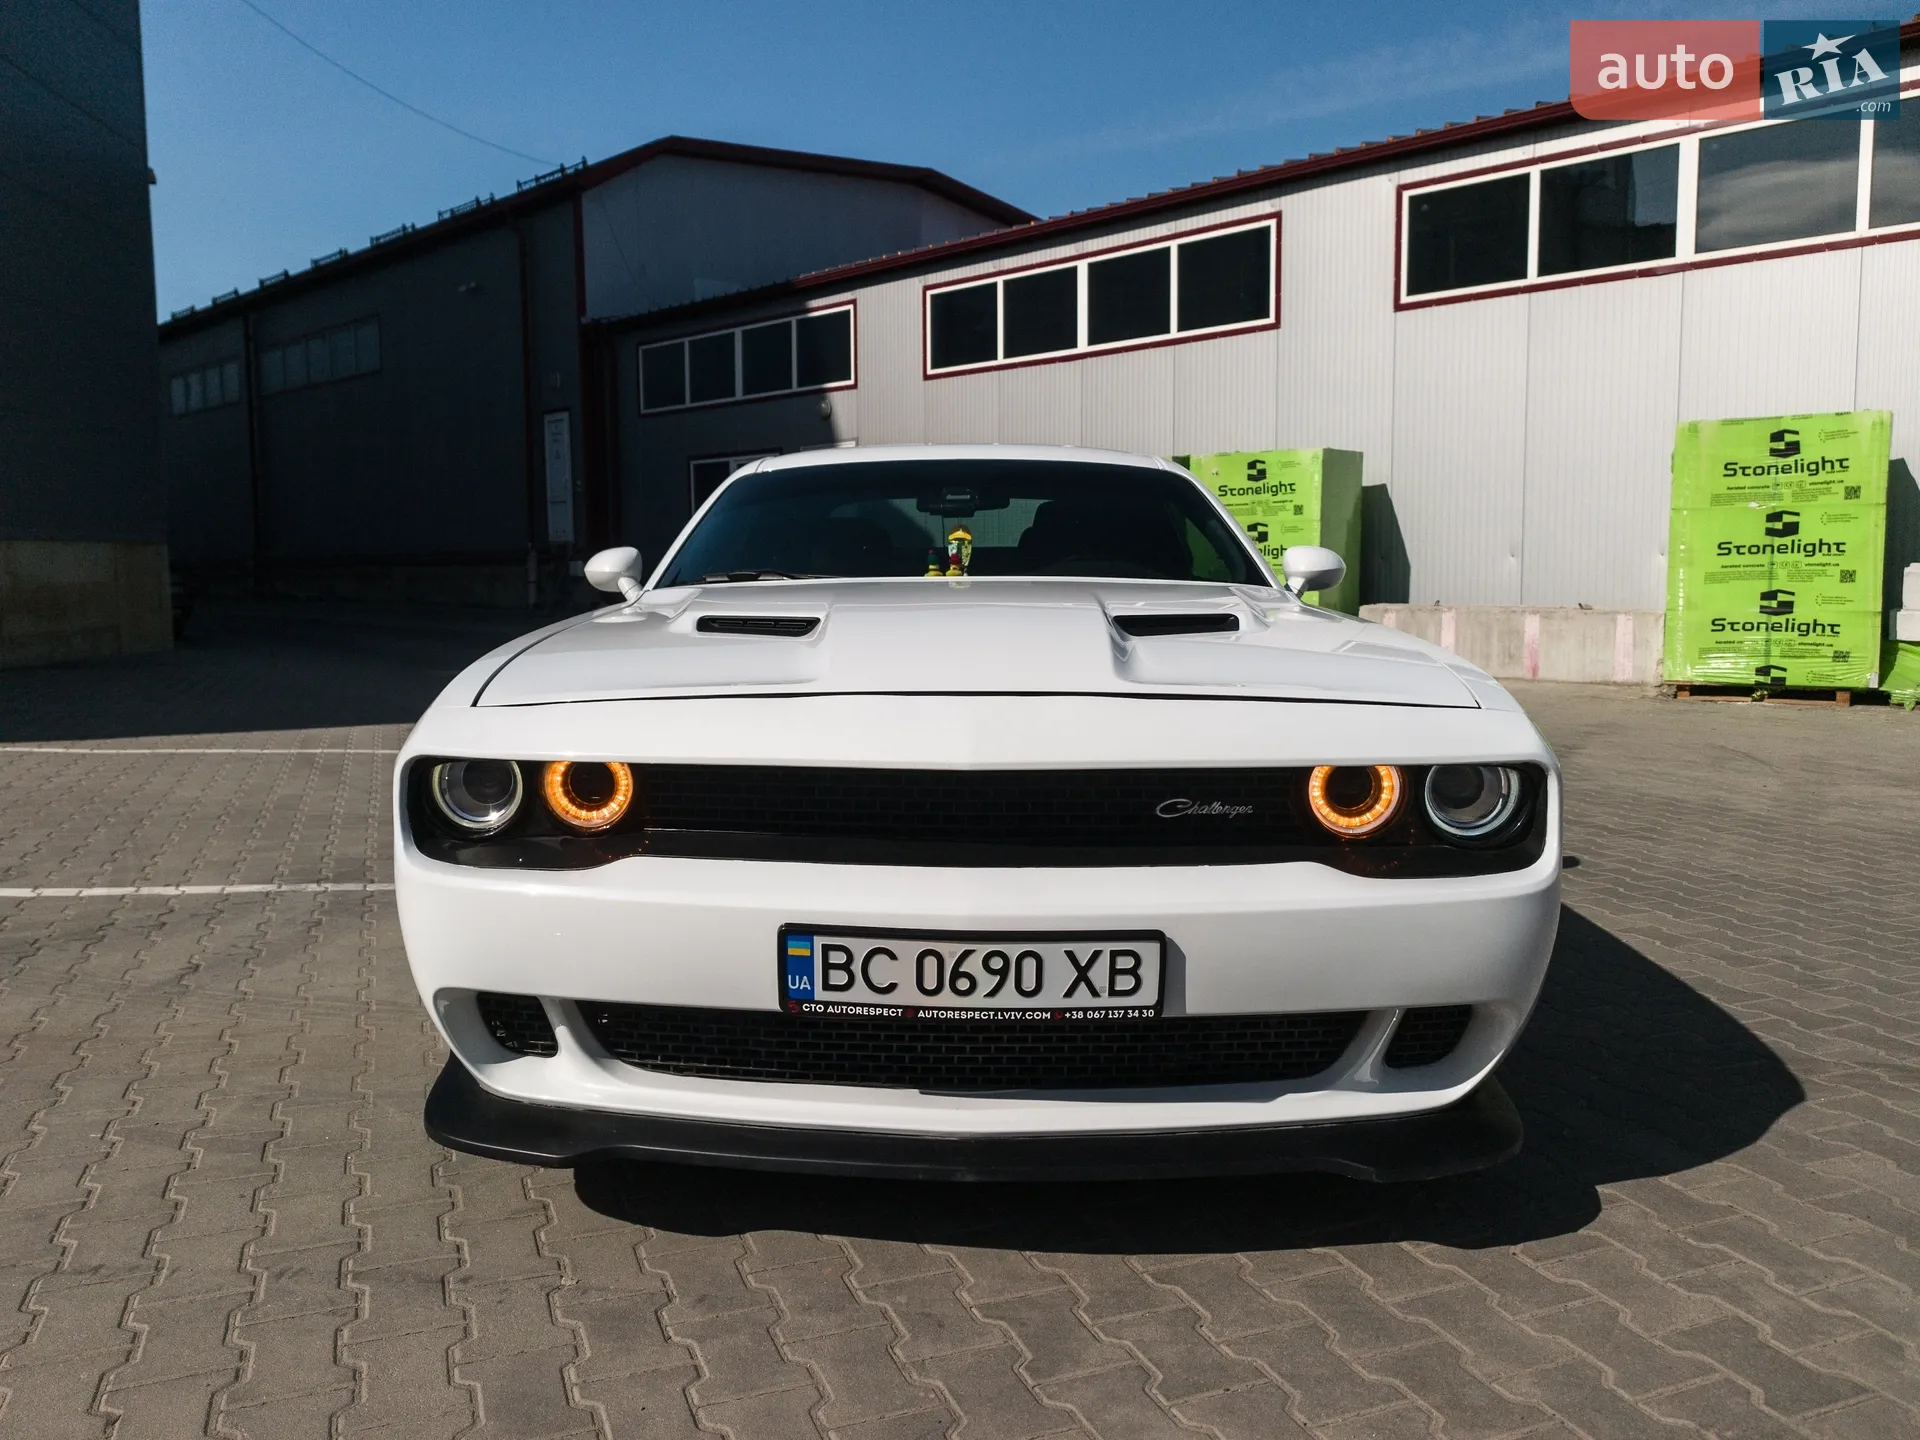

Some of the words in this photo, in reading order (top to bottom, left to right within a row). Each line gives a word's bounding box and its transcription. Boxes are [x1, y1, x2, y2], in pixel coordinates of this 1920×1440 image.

[1723, 456, 1850, 477] Stonelight
[1218, 481, 1296, 496] Stonelight
[1717, 538, 1846, 557] Stonelight
[1711, 618, 1840, 637] Stonelight
[1156, 798, 1253, 819] Challenger
[820, 942, 898, 995] BC
[915, 947, 1044, 998] 0690
[1063, 949, 1143, 999] XB
[787, 974, 811, 991] UA
[802, 1003, 824, 1012] CTO
[827, 1005, 903, 1017] AUTORESPECT
[917, 1010, 1051, 1020] AUTORESPECT.LVIV.COM
[1064, 1010, 1084, 1019] +38
[1086, 1010, 1105, 1019] 067
[1107, 1009, 1126, 1019] 137
[1127, 1009, 1140, 1018] 34
[1141, 1009, 1155, 1018] 30
